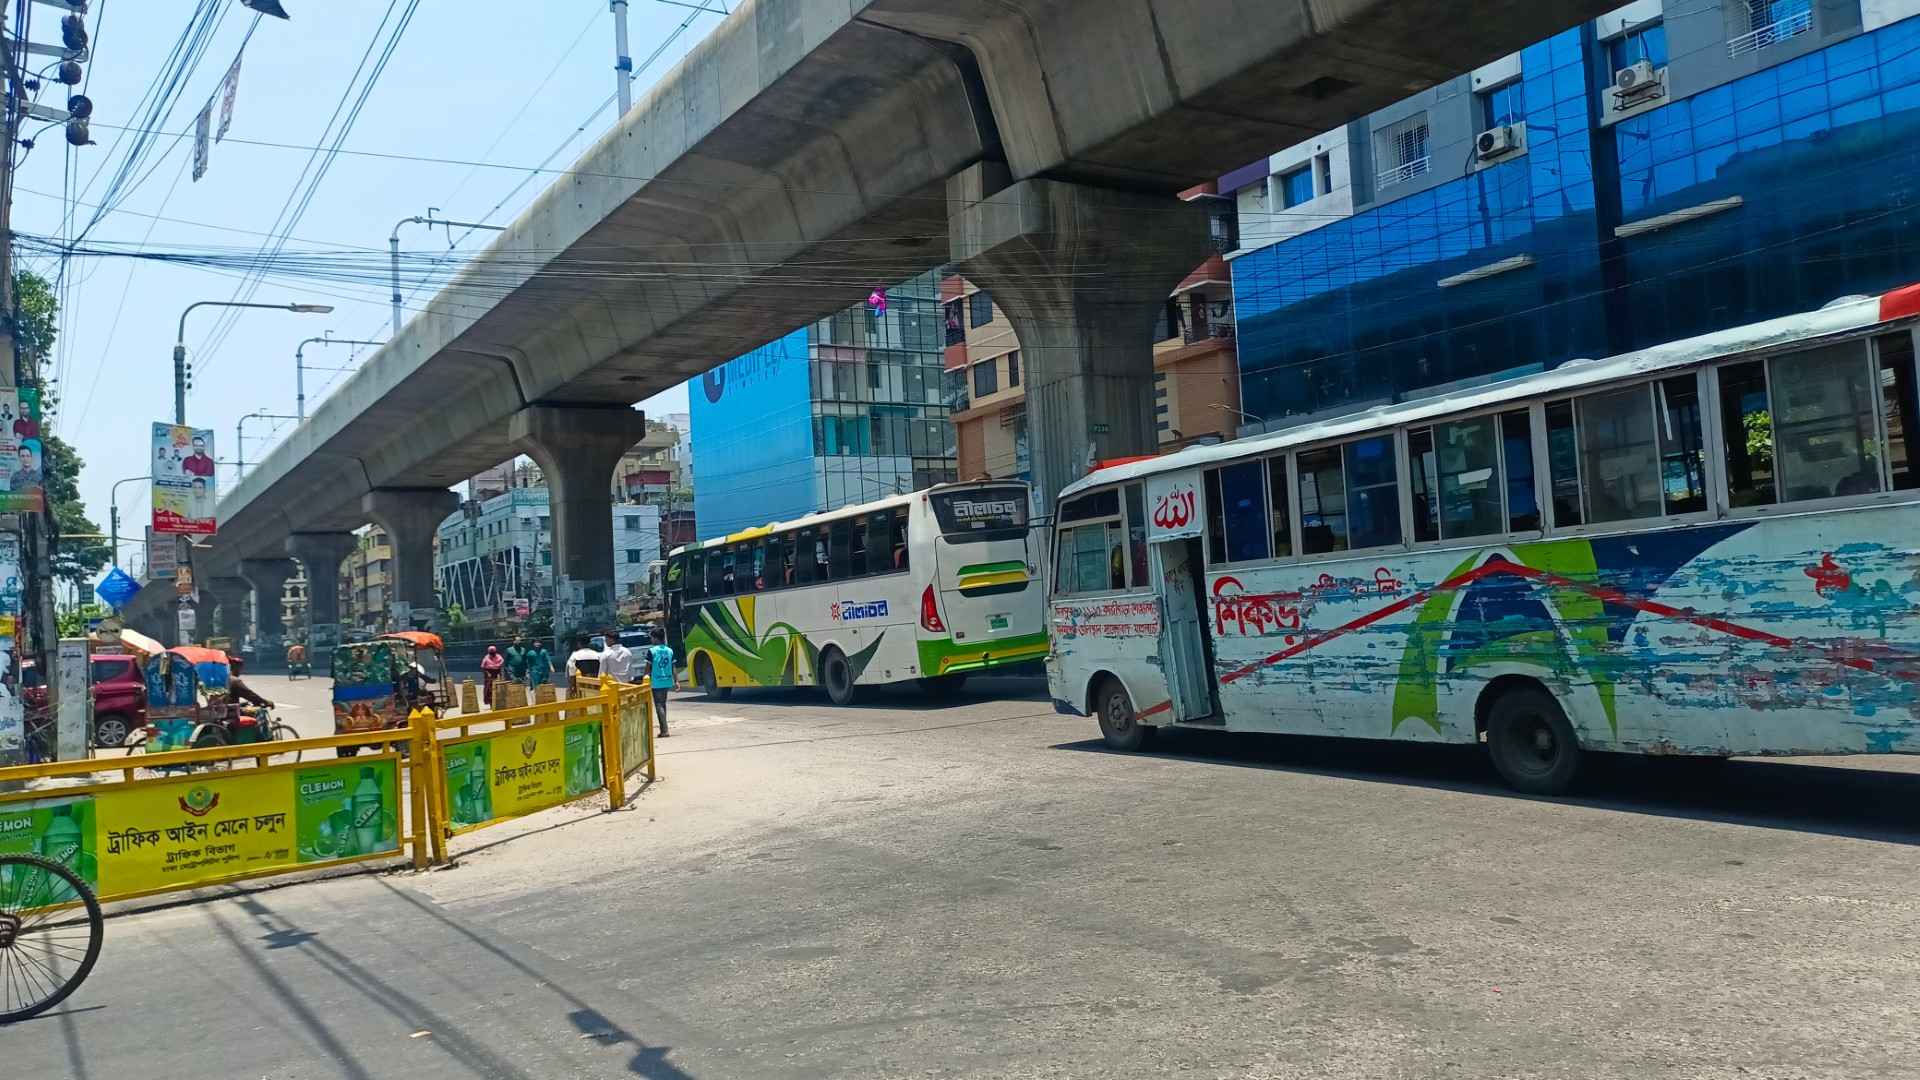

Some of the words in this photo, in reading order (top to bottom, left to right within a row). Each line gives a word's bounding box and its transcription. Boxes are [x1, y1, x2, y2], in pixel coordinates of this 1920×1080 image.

[300, 778, 345, 795] CLEMON
[107, 827, 161, 856] ট্রাফিক
[165, 820, 209, 844] আইন
[213, 817, 249, 838] মেনে
[253, 812, 287, 833] চলুন
